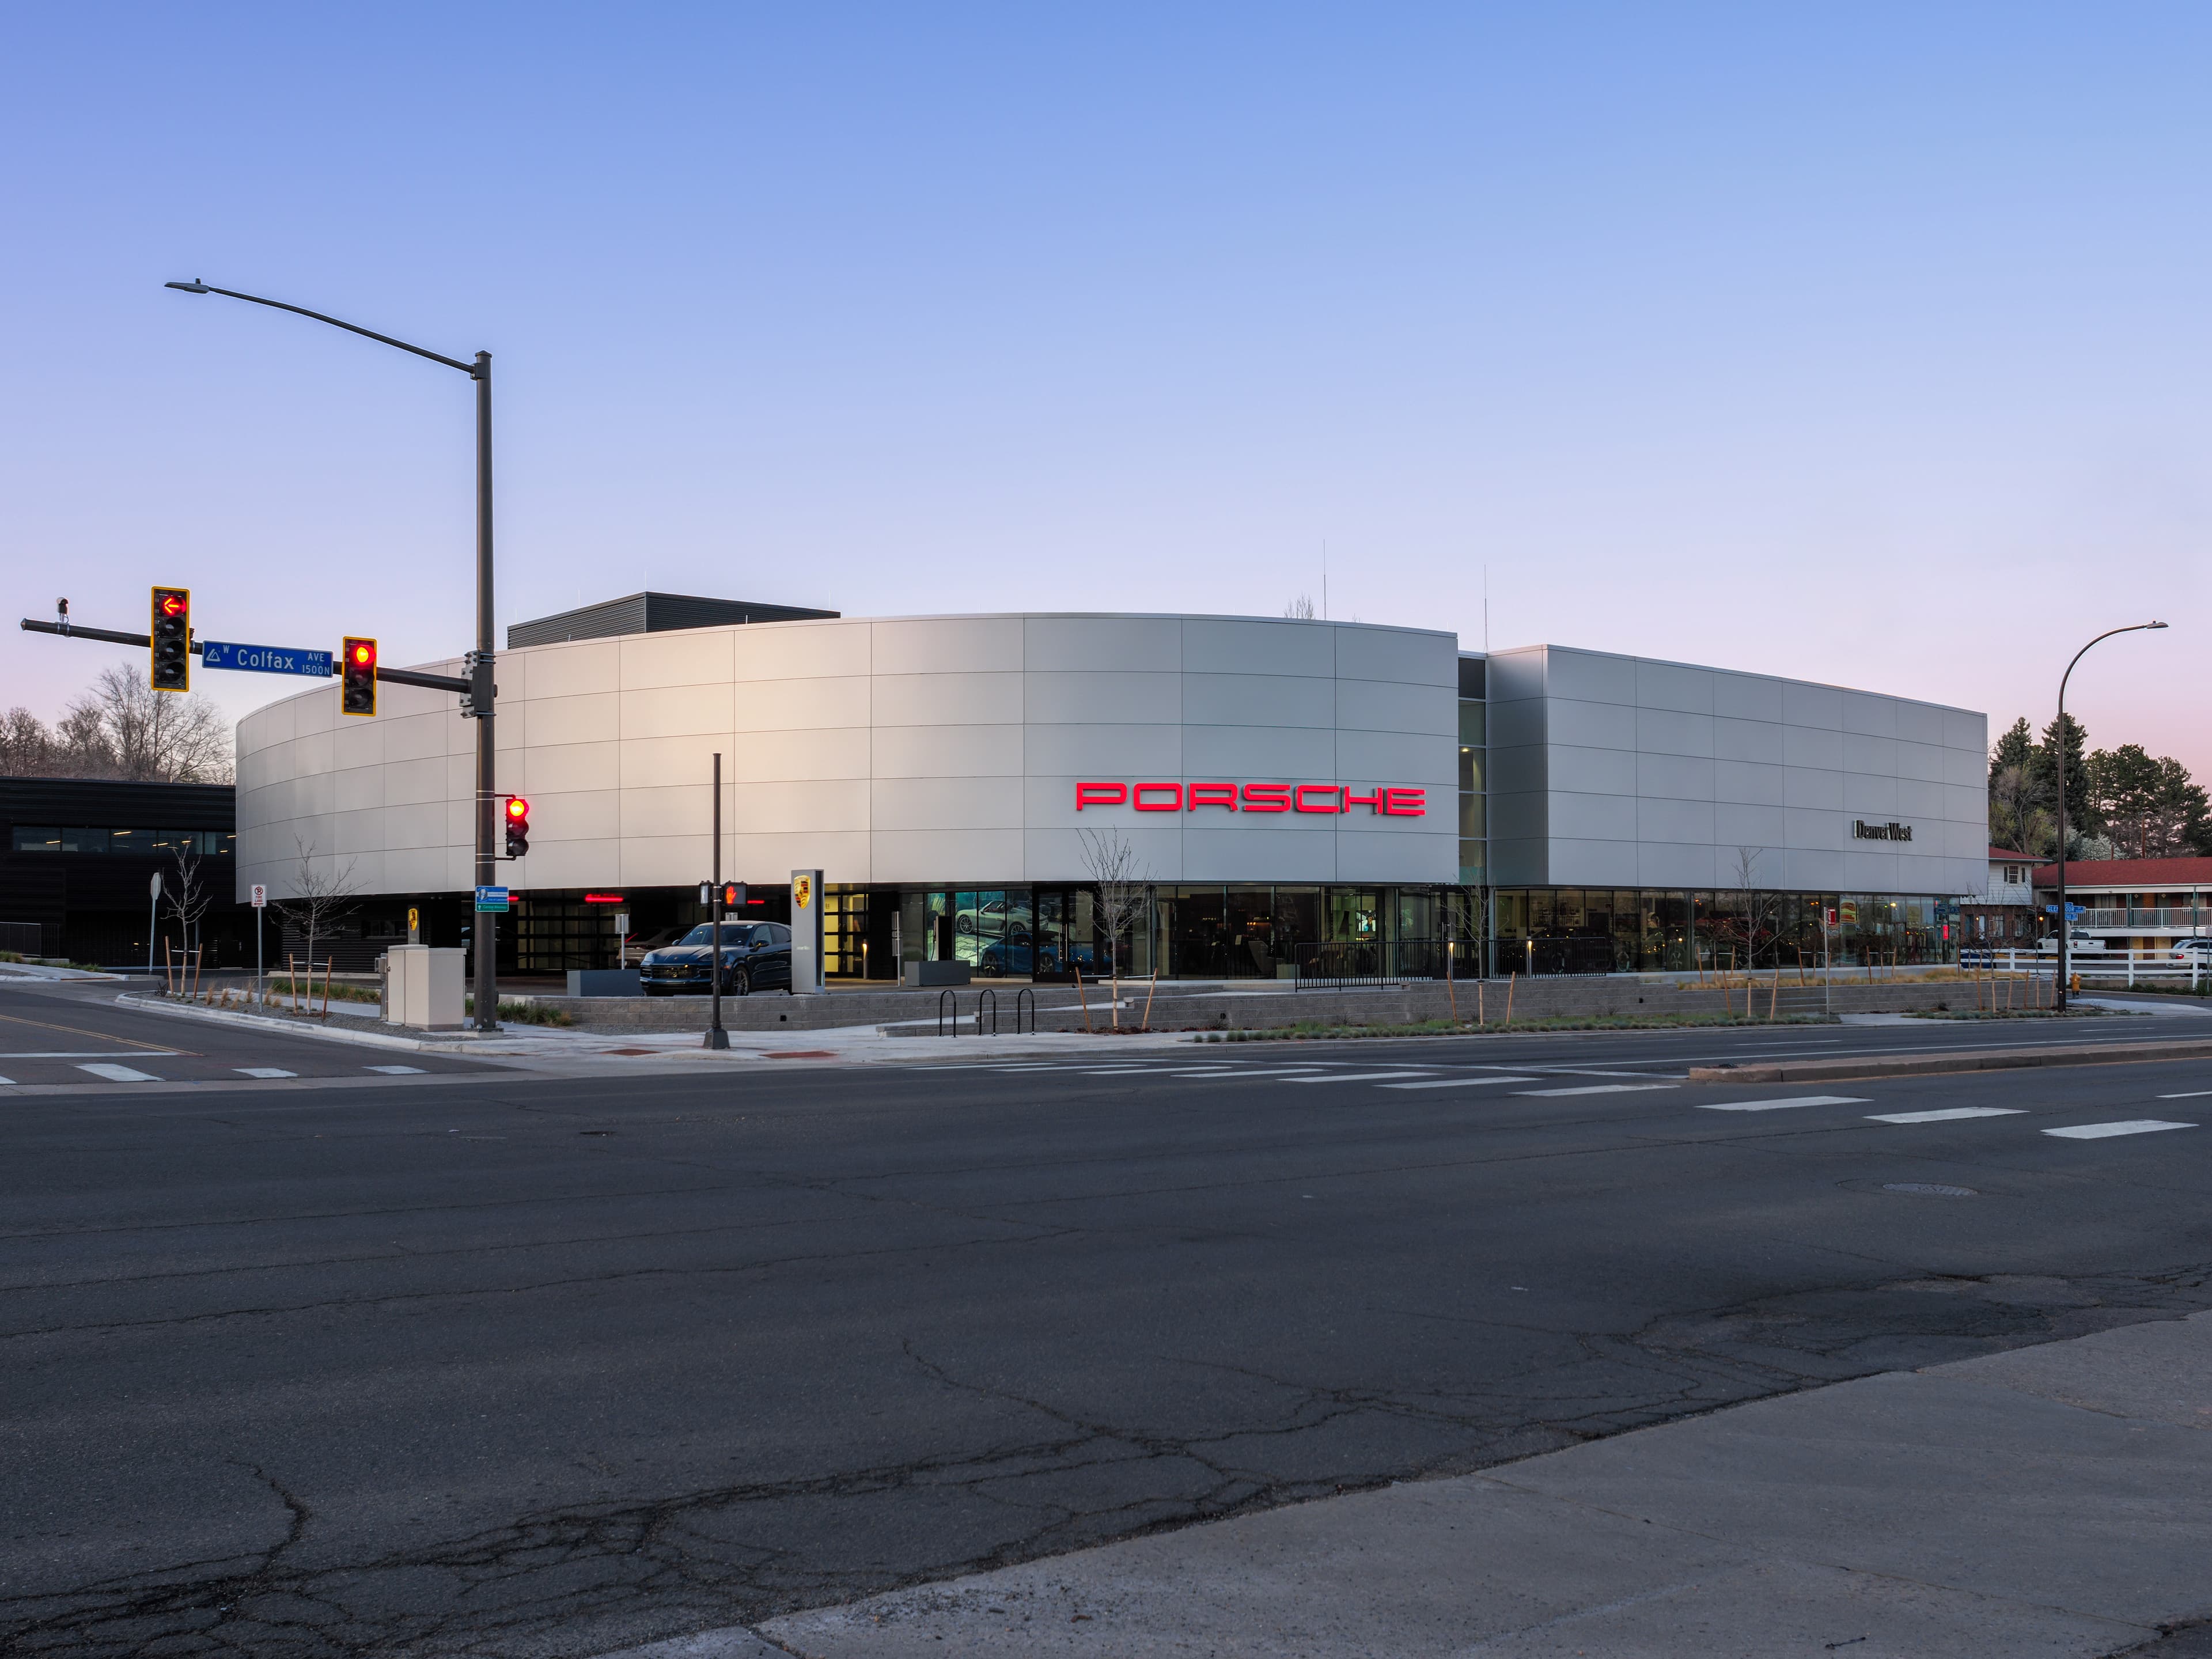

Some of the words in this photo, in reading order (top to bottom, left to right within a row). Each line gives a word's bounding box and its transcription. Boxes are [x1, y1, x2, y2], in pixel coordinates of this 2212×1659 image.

[223, 645, 230, 653] W
[237, 649, 294, 669] Colfax
[308, 653, 325, 662] AVE
[302, 665, 330, 675] 1500N
[1076, 782, 1426, 816] PORSCHE
[1854, 820, 1889, 839] Denver
[1887, 823, 1912, 841] West
